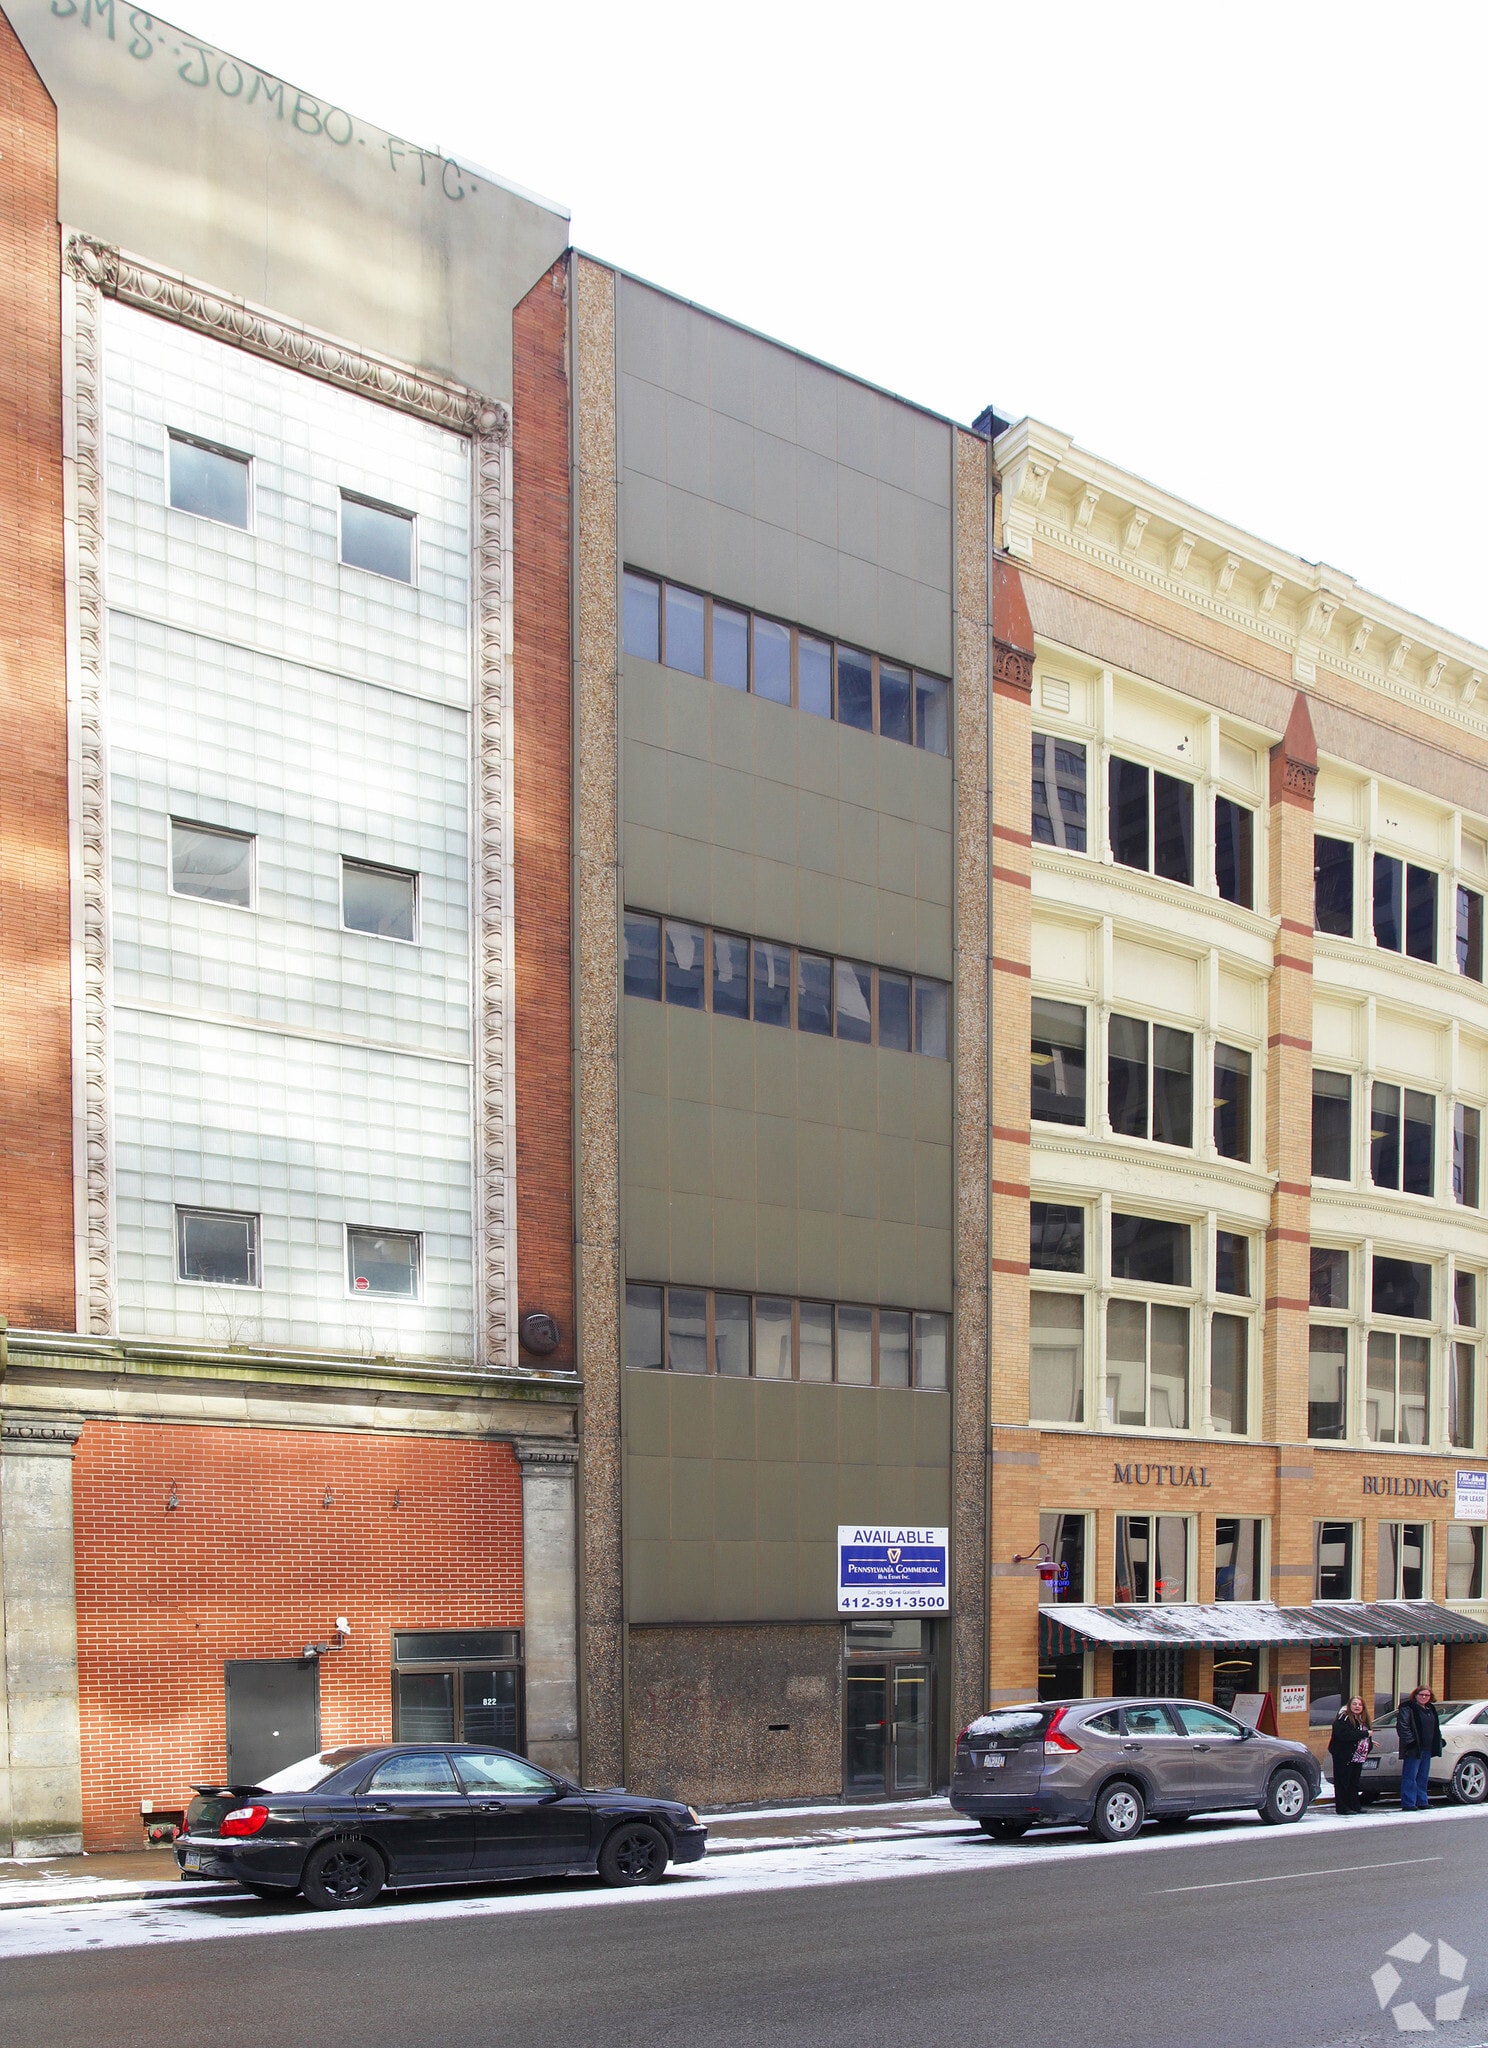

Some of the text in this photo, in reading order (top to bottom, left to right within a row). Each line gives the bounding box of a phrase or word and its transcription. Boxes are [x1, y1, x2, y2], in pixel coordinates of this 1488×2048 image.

[1113, 1463, 1451, 1499] MUTUAL BUILDING
[853, 1530, 935, 1544] AVAILABLE
[848, 1564, 939, 1574] PENNSYLVANIA COMMERCIAL
[841, 1597, 945, 1608] 412-391-3500
[482, 1698, 497, 1706] 822
